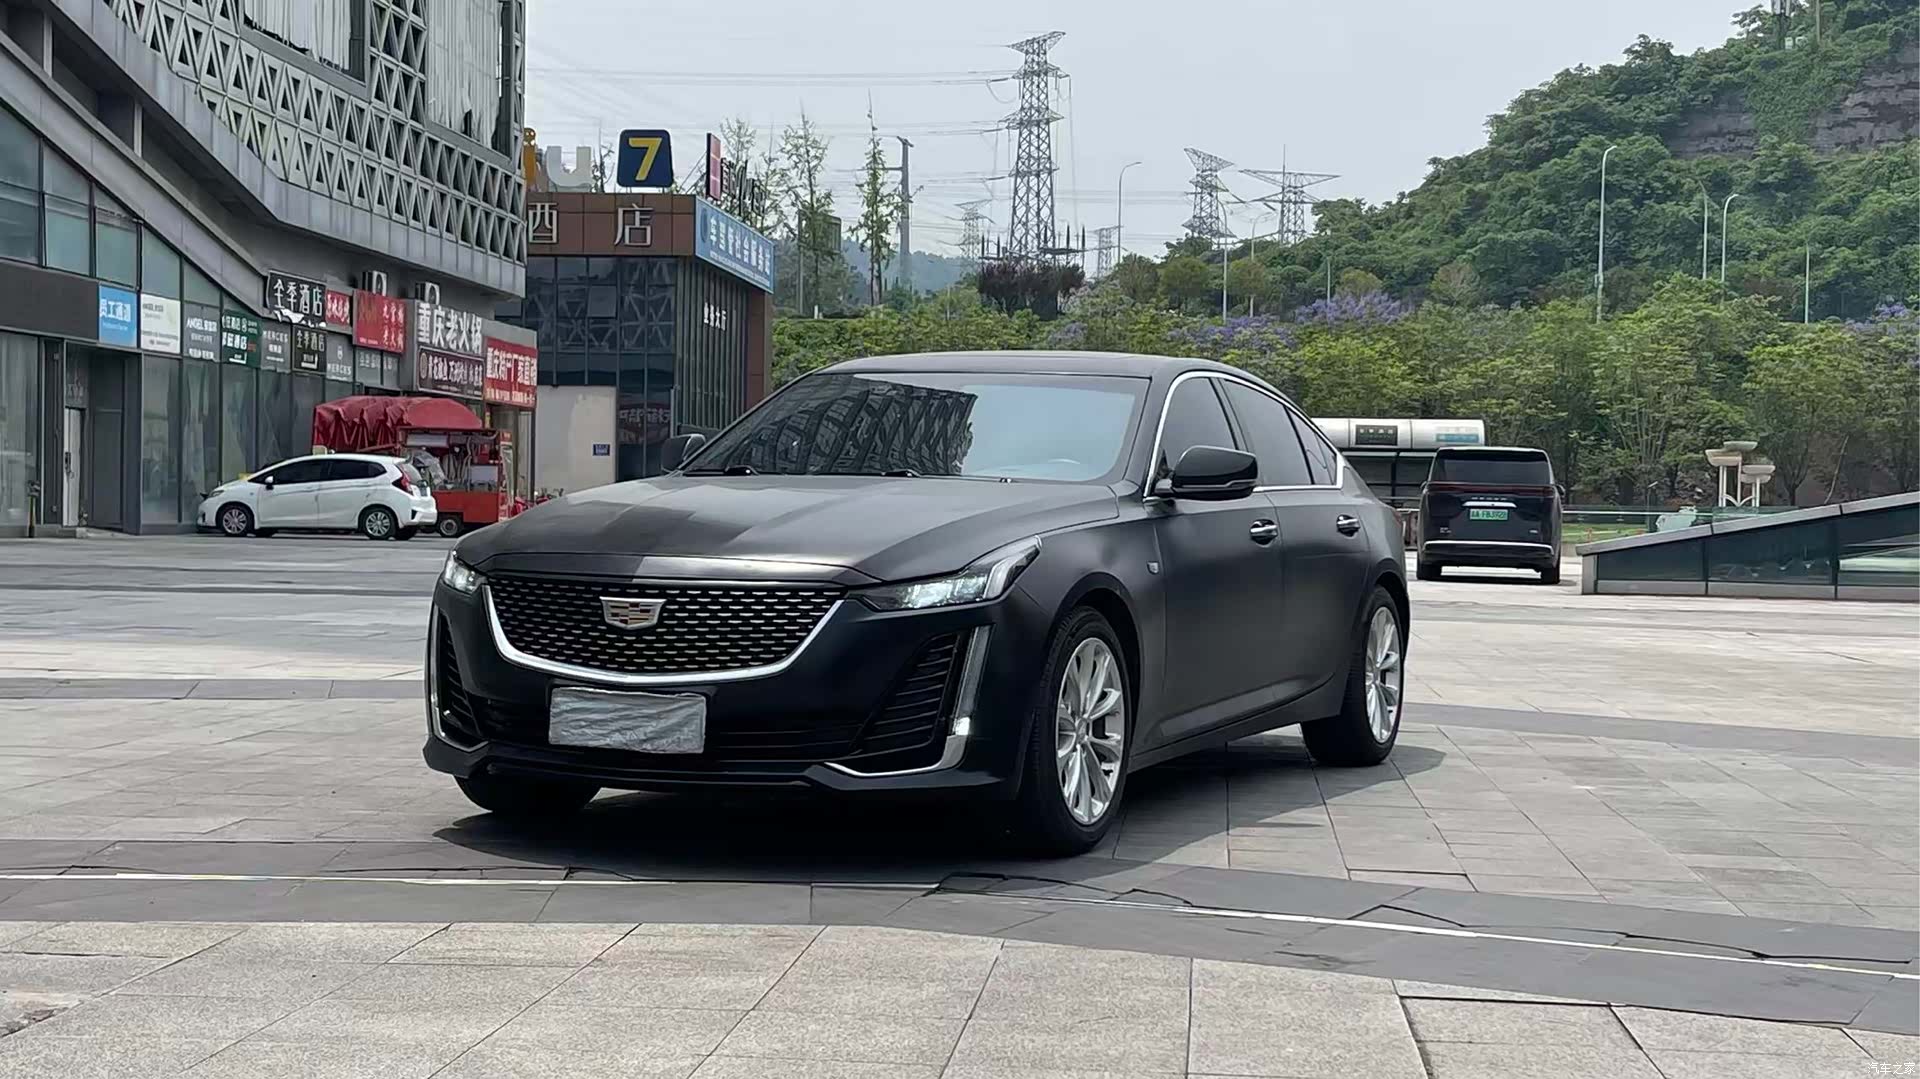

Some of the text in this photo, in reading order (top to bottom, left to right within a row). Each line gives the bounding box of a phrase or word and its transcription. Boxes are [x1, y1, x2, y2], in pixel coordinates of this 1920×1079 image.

[628, 137, 662, 181] 7
[528, 202, 653, 247] 酒店
[273, 278, 323, 317] 全季酒店
[296, 329, 325, 352] 全季酒店
[418, 302, 482, 355] 重庆老火锅
